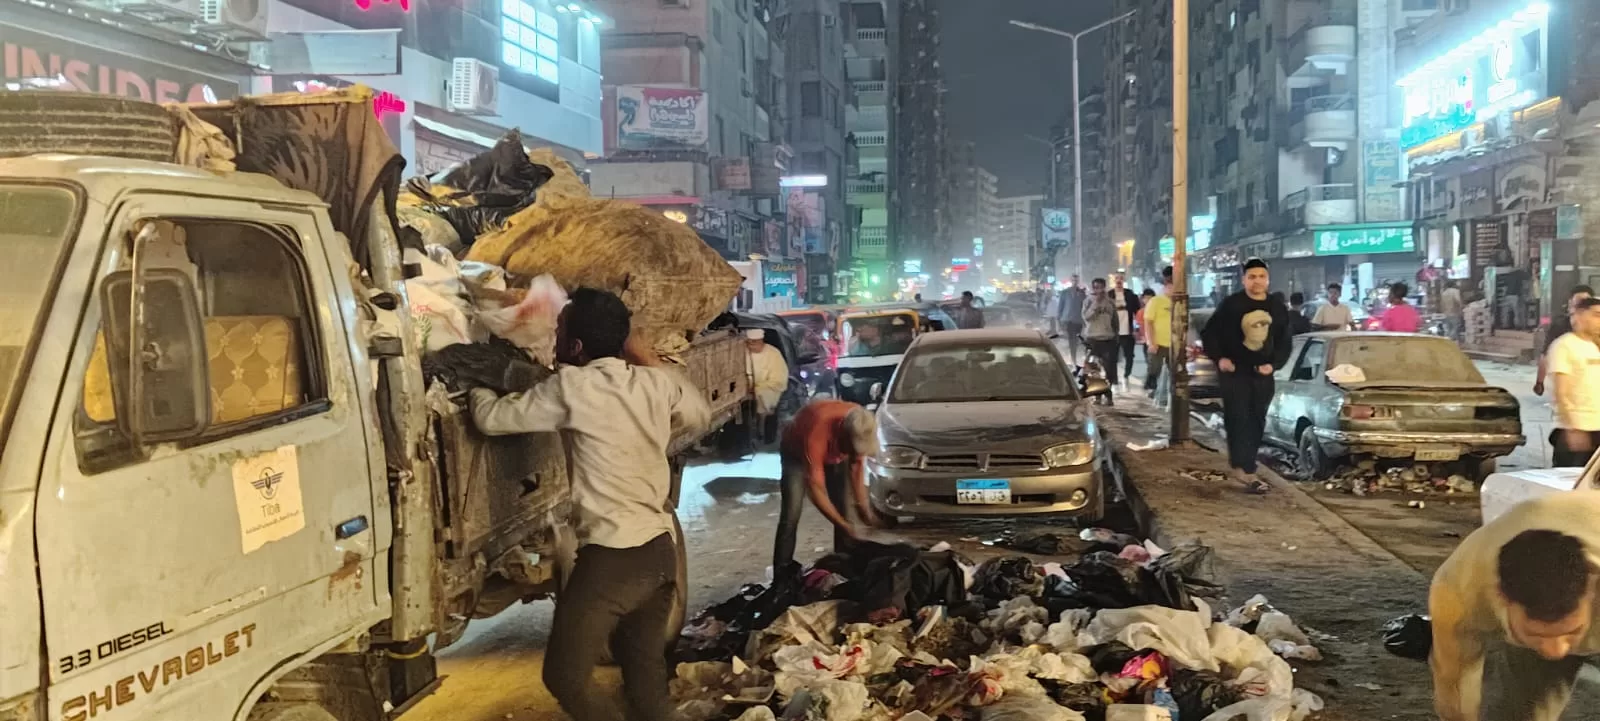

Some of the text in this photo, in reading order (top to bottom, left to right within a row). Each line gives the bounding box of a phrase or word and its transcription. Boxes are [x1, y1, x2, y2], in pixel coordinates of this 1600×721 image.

[60, 621, 174, 674] 3.3 DIESEL
[60, 623, 256, 721] CHEVROLET
